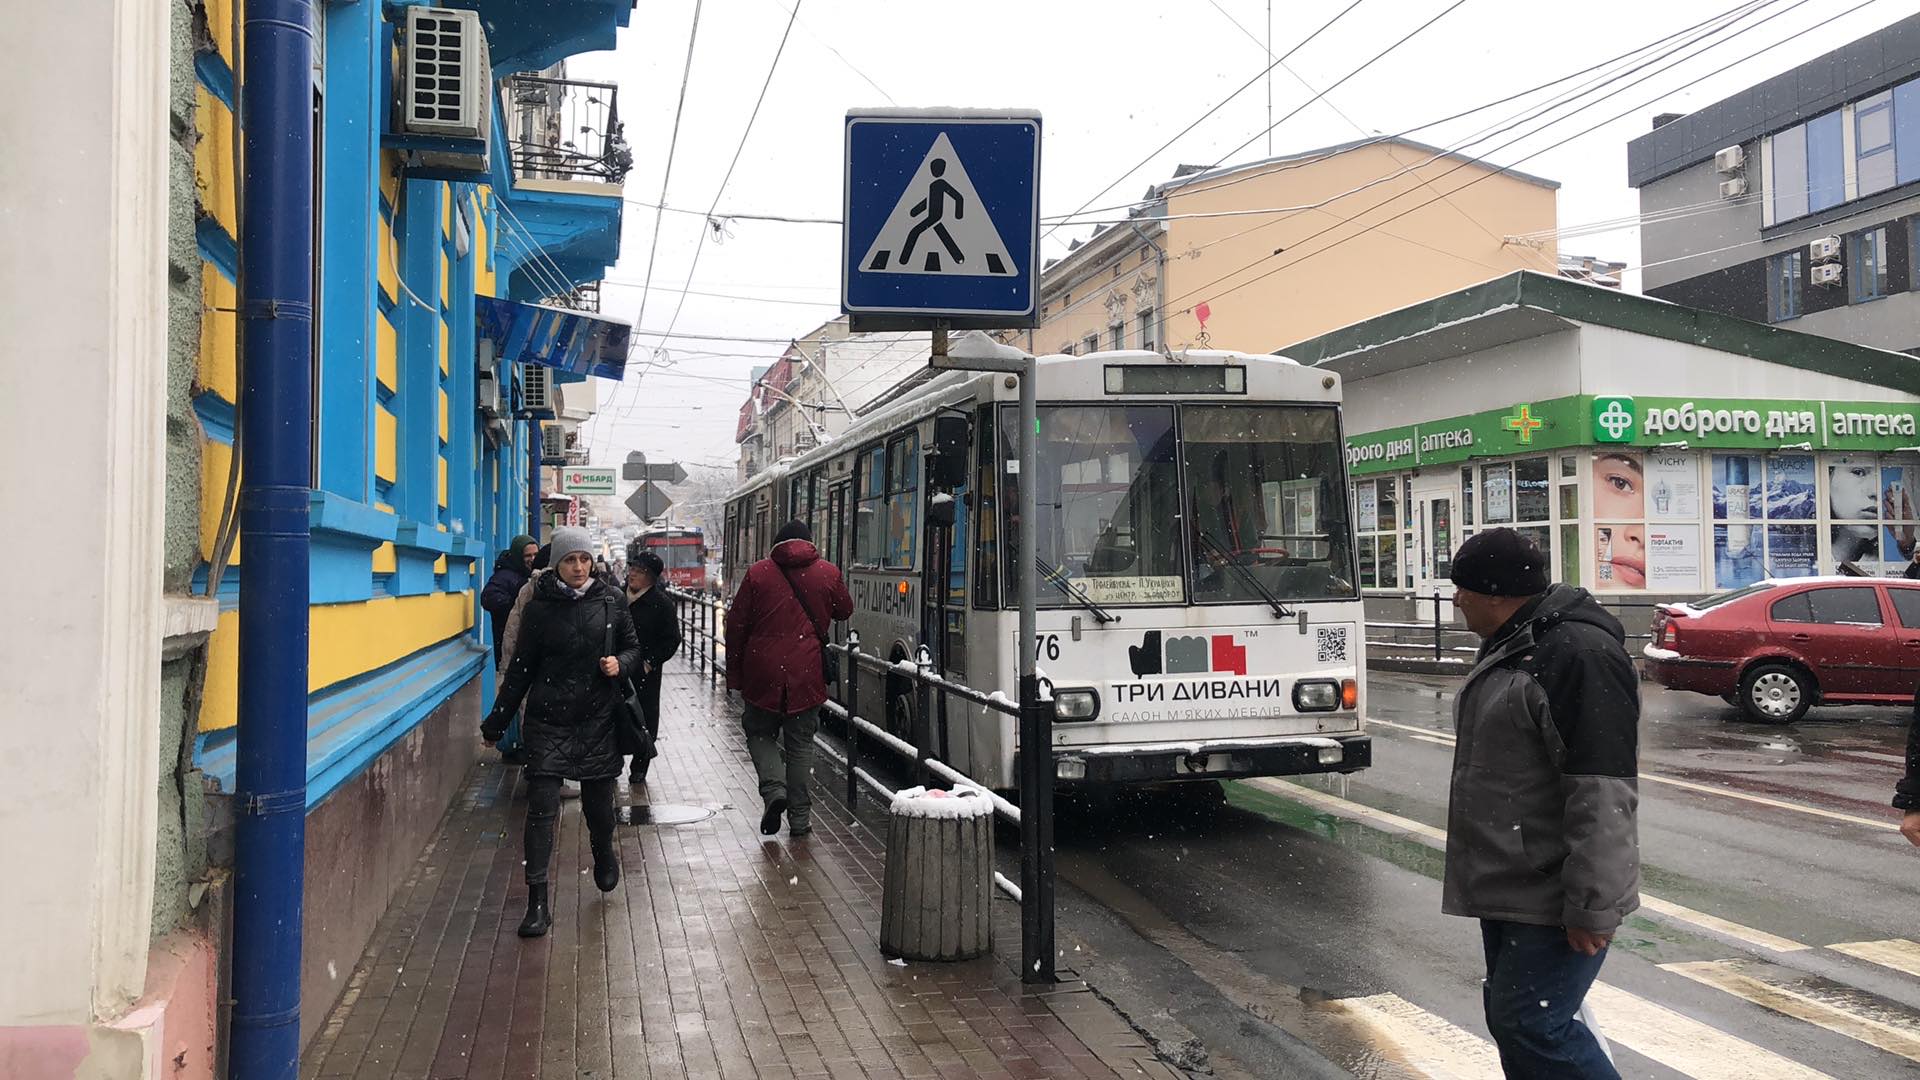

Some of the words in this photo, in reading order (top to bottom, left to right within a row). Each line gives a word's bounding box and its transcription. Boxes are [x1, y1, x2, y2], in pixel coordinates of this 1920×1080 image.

[1644, 402, 1761, 438] доброго
[1766, 410, 1816, 439] дня
[1832, 412, 1916, 437] аптека
[1386, 438, 1414, 462] дня
[1421, 428, 1473, 452] аптека
[1657, 457, 1687, 466] VICHY
[565, 473, 613, 484] ЛОМБАРД
[853, 578, 870, 610] ТРИ
[871, 579, 915, 619] ДИВАНИ
[1112, 682, 1164, 702] ТРИ
[1172, 679, 1280, 701] ДИВАНИ
[1112, 710, 1161, 722] САЛОН
[1228, 706, 1282, 718] МЕБЛІВ
